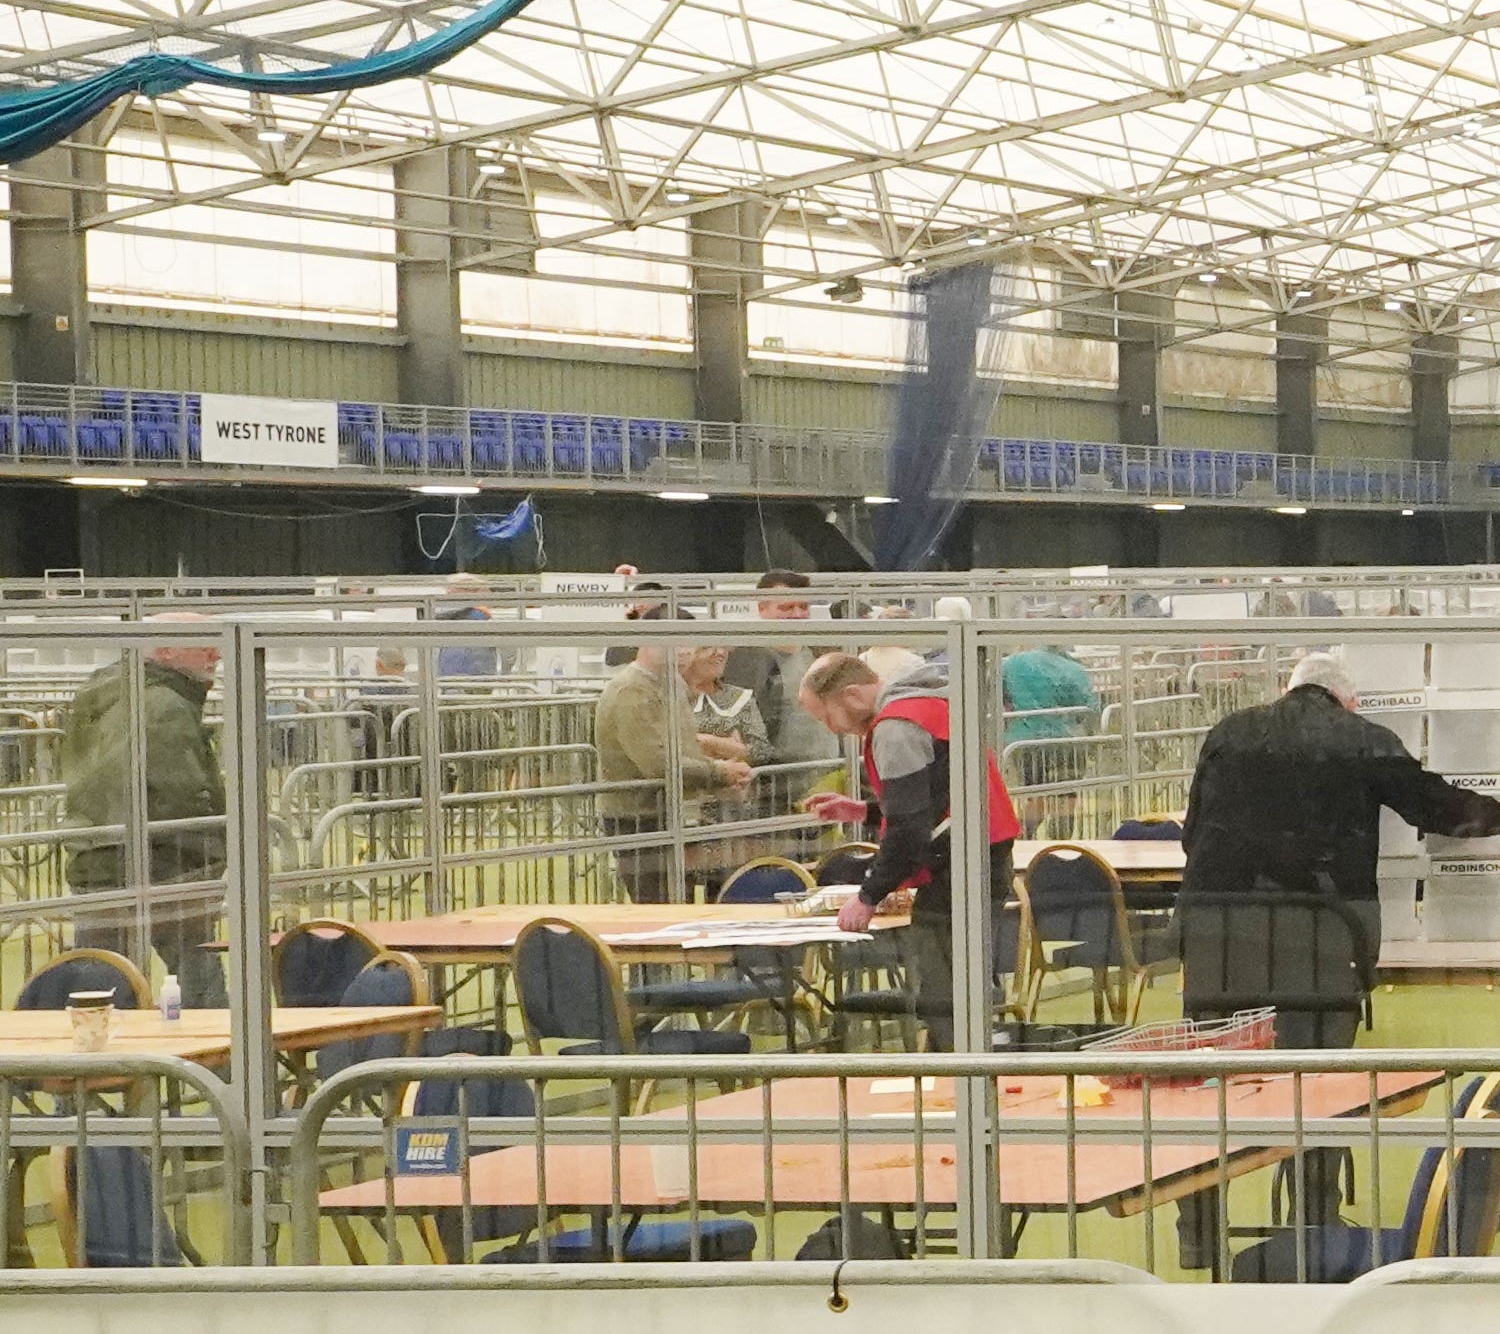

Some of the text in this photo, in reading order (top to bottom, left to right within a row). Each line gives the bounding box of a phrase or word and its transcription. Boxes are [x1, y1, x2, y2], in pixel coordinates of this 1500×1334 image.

[216, 420, 327, 444] WEST TYRONE
[555, 582, 610, 593] NEWRY
[721, 603, 751, 614] BANN
[1451, 778, 1497, 787] MCCAW
